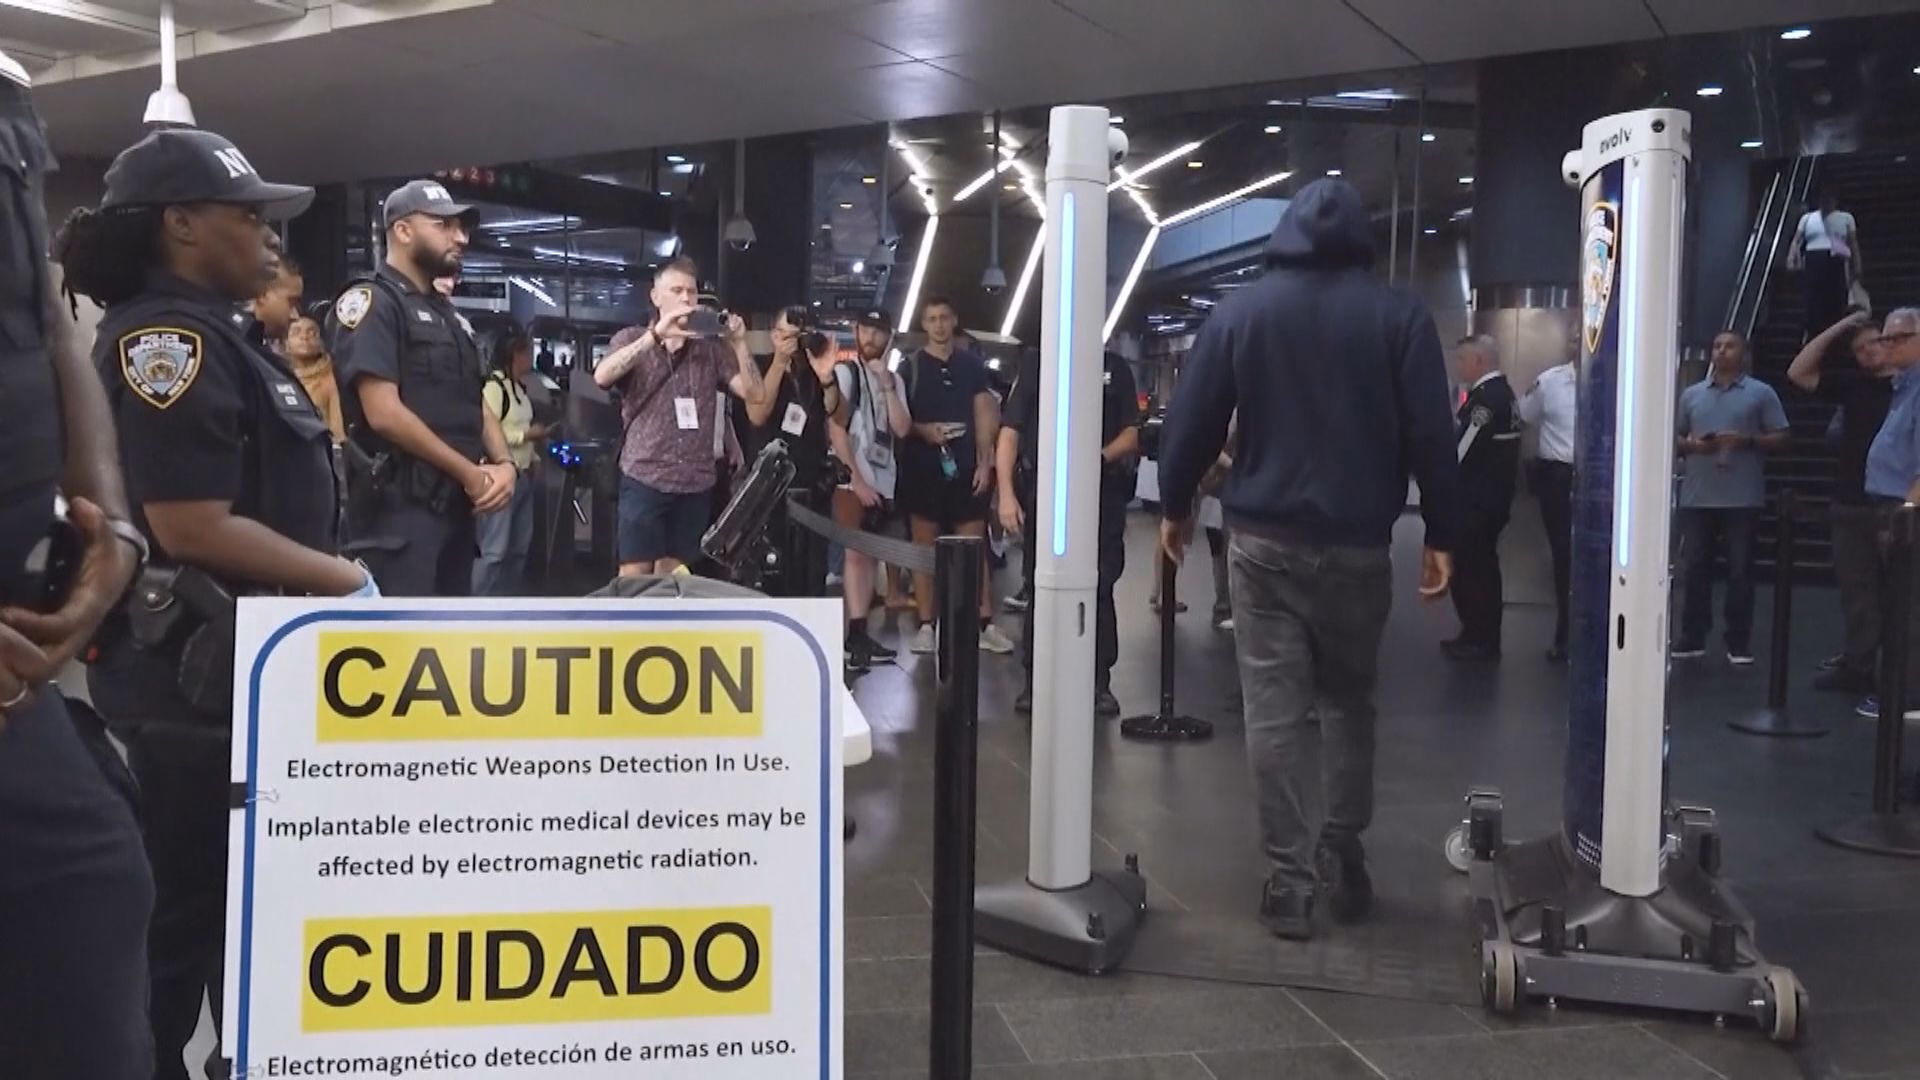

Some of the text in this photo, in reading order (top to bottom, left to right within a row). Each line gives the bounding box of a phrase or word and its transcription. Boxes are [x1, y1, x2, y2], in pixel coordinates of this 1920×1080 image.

[1600, 127, 1632, 154] evolv
[323, 646, 753, 718] CAUTION
[287, 753, 790, 782] Electromagnetic Weapons Detection In Use.
[267, 807, 806, 841] Implantable electronic medical devices may be
[317, 847, 759, 878] affected by electromagnetic radiation.
[308, 921, 760, 1007] CUIDADO
[267, 1039, 797, 1077] Electromagnético detección de armas en uso.
